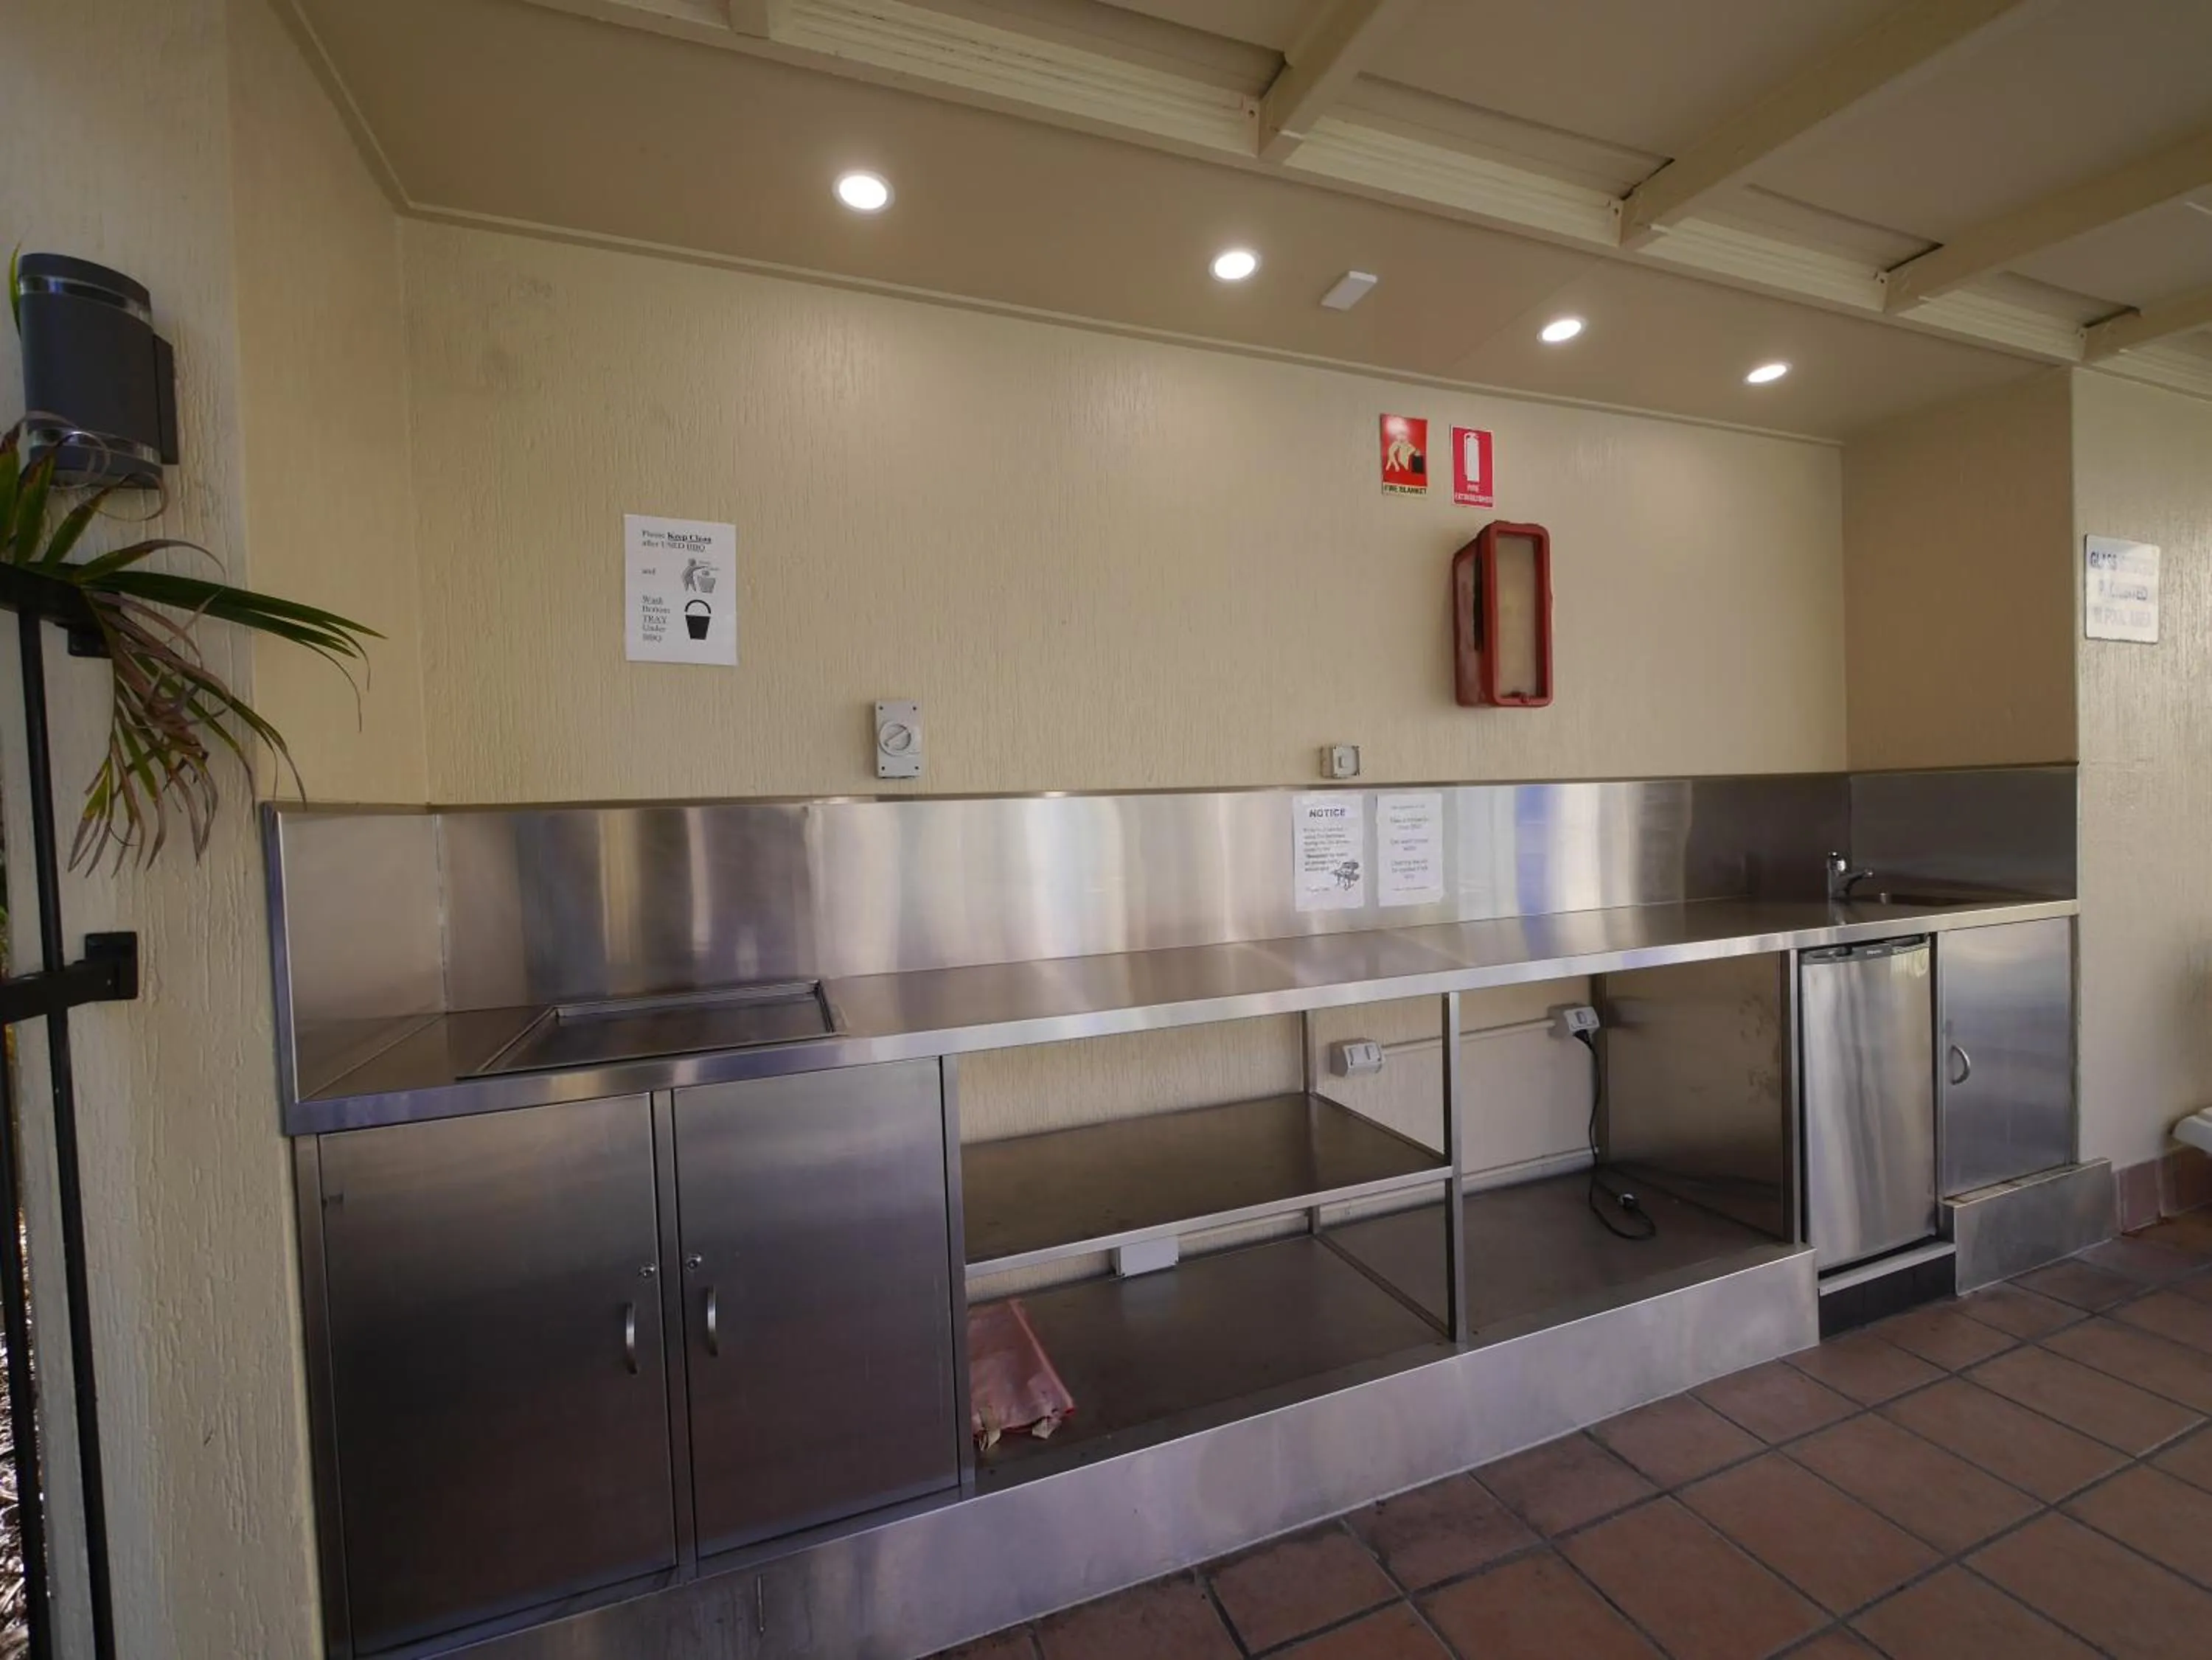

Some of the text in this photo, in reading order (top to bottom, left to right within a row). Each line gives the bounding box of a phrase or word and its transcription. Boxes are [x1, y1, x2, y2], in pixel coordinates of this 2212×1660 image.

[667, 531, 687, 543] Keep
[689, 534, 712, 545] Clean
[643, 615, 667, 624] TRAY
[1309, 808, 1346, 818] NOTICE
